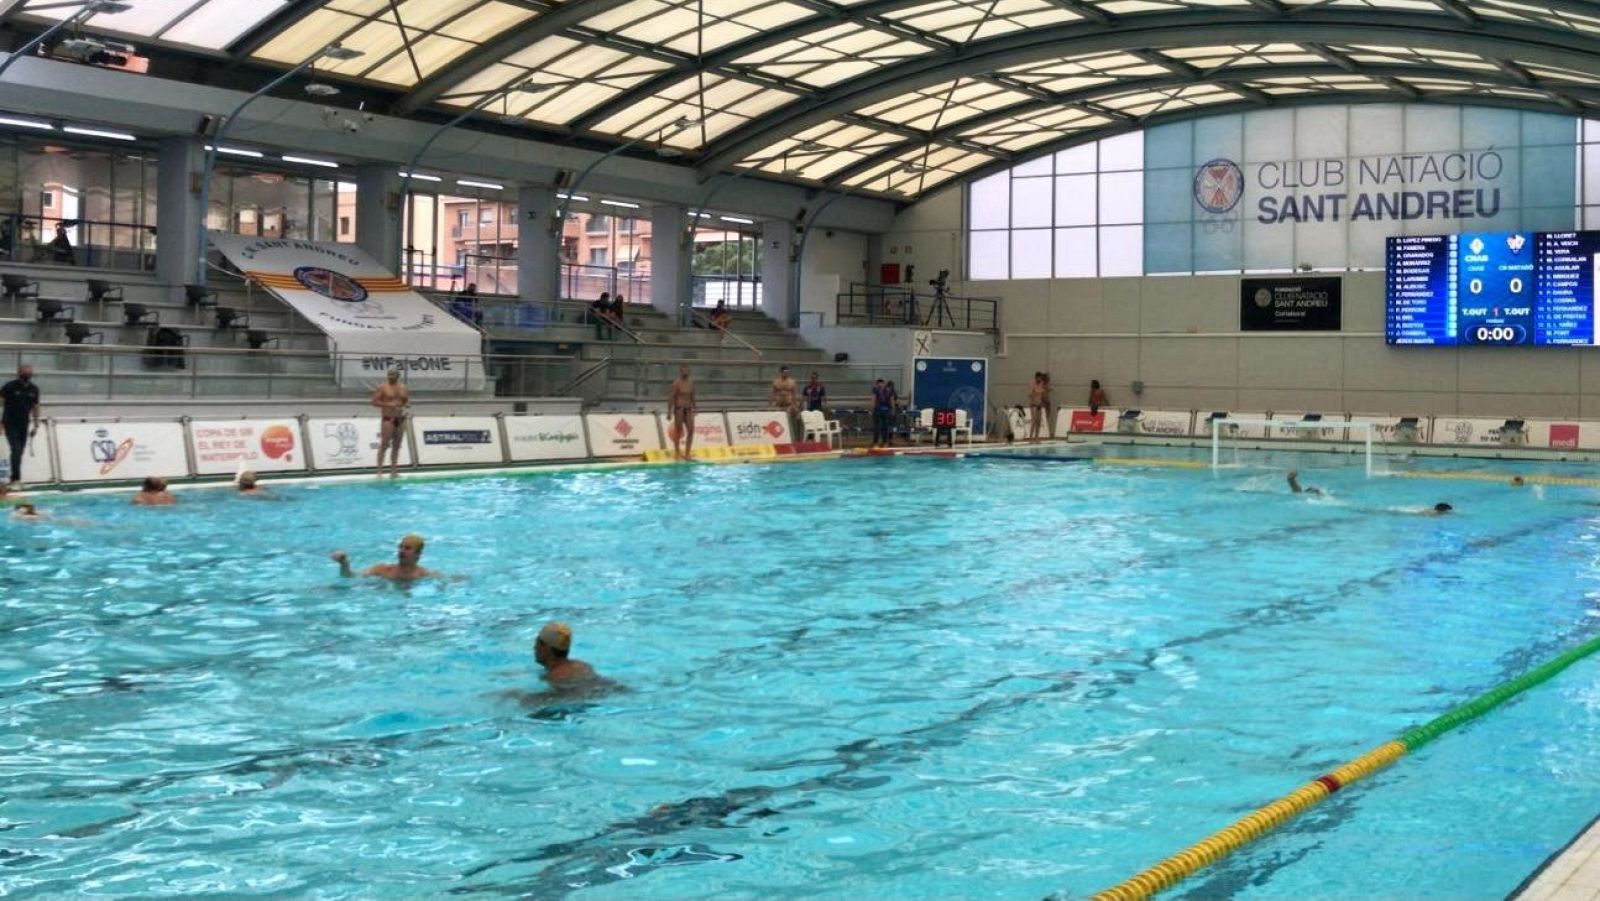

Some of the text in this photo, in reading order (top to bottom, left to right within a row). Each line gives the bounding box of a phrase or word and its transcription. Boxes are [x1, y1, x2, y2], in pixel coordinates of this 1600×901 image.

[1257, 145, 1503, 189] CLUB NATACIÓ
[1257, 188, 1501, 224] SANT ANDREU
[1470, 279, 1482, 294] 0
[1510, 278, 1522, 293] 0
[1477, 328, 1514, 340] 0:00
[937, 412, 955, 424] 30
